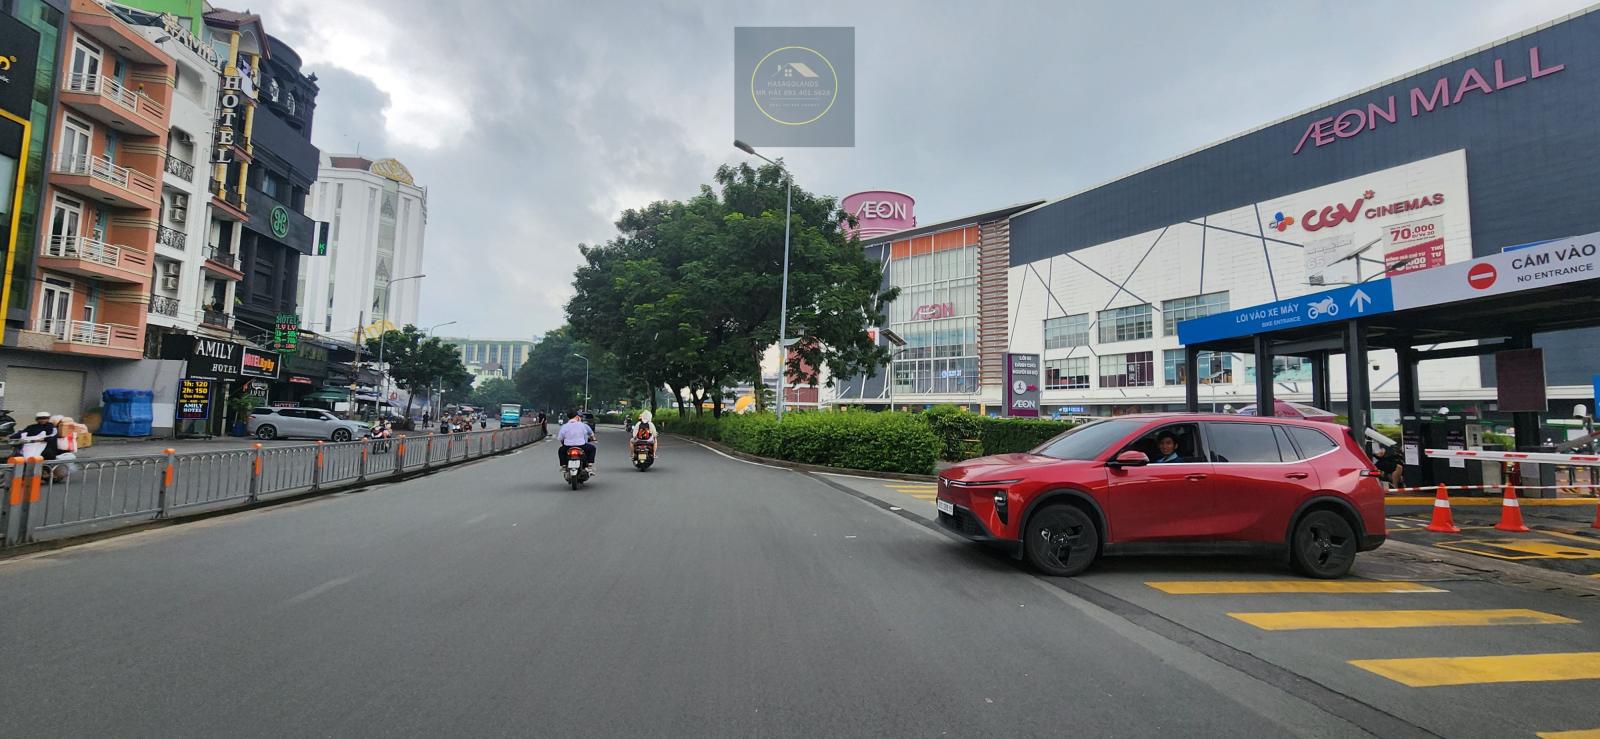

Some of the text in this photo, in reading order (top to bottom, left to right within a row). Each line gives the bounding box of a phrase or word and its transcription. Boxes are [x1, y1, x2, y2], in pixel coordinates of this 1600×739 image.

[1410, 46, 1565, 117] MALL
[216, 75, 241, 163] HOTEL
[1301, 193, 1445, 231] CGV CINEMAS
[1554, 243, 1597, 261] VÀO
[1517, 262, 1594, 283] NO ENTRANCE
[1268, 307, 1279, 317] XE
[195, 340, 234, 360] AMILY
[212, 364, 238, 374] HOTEL
